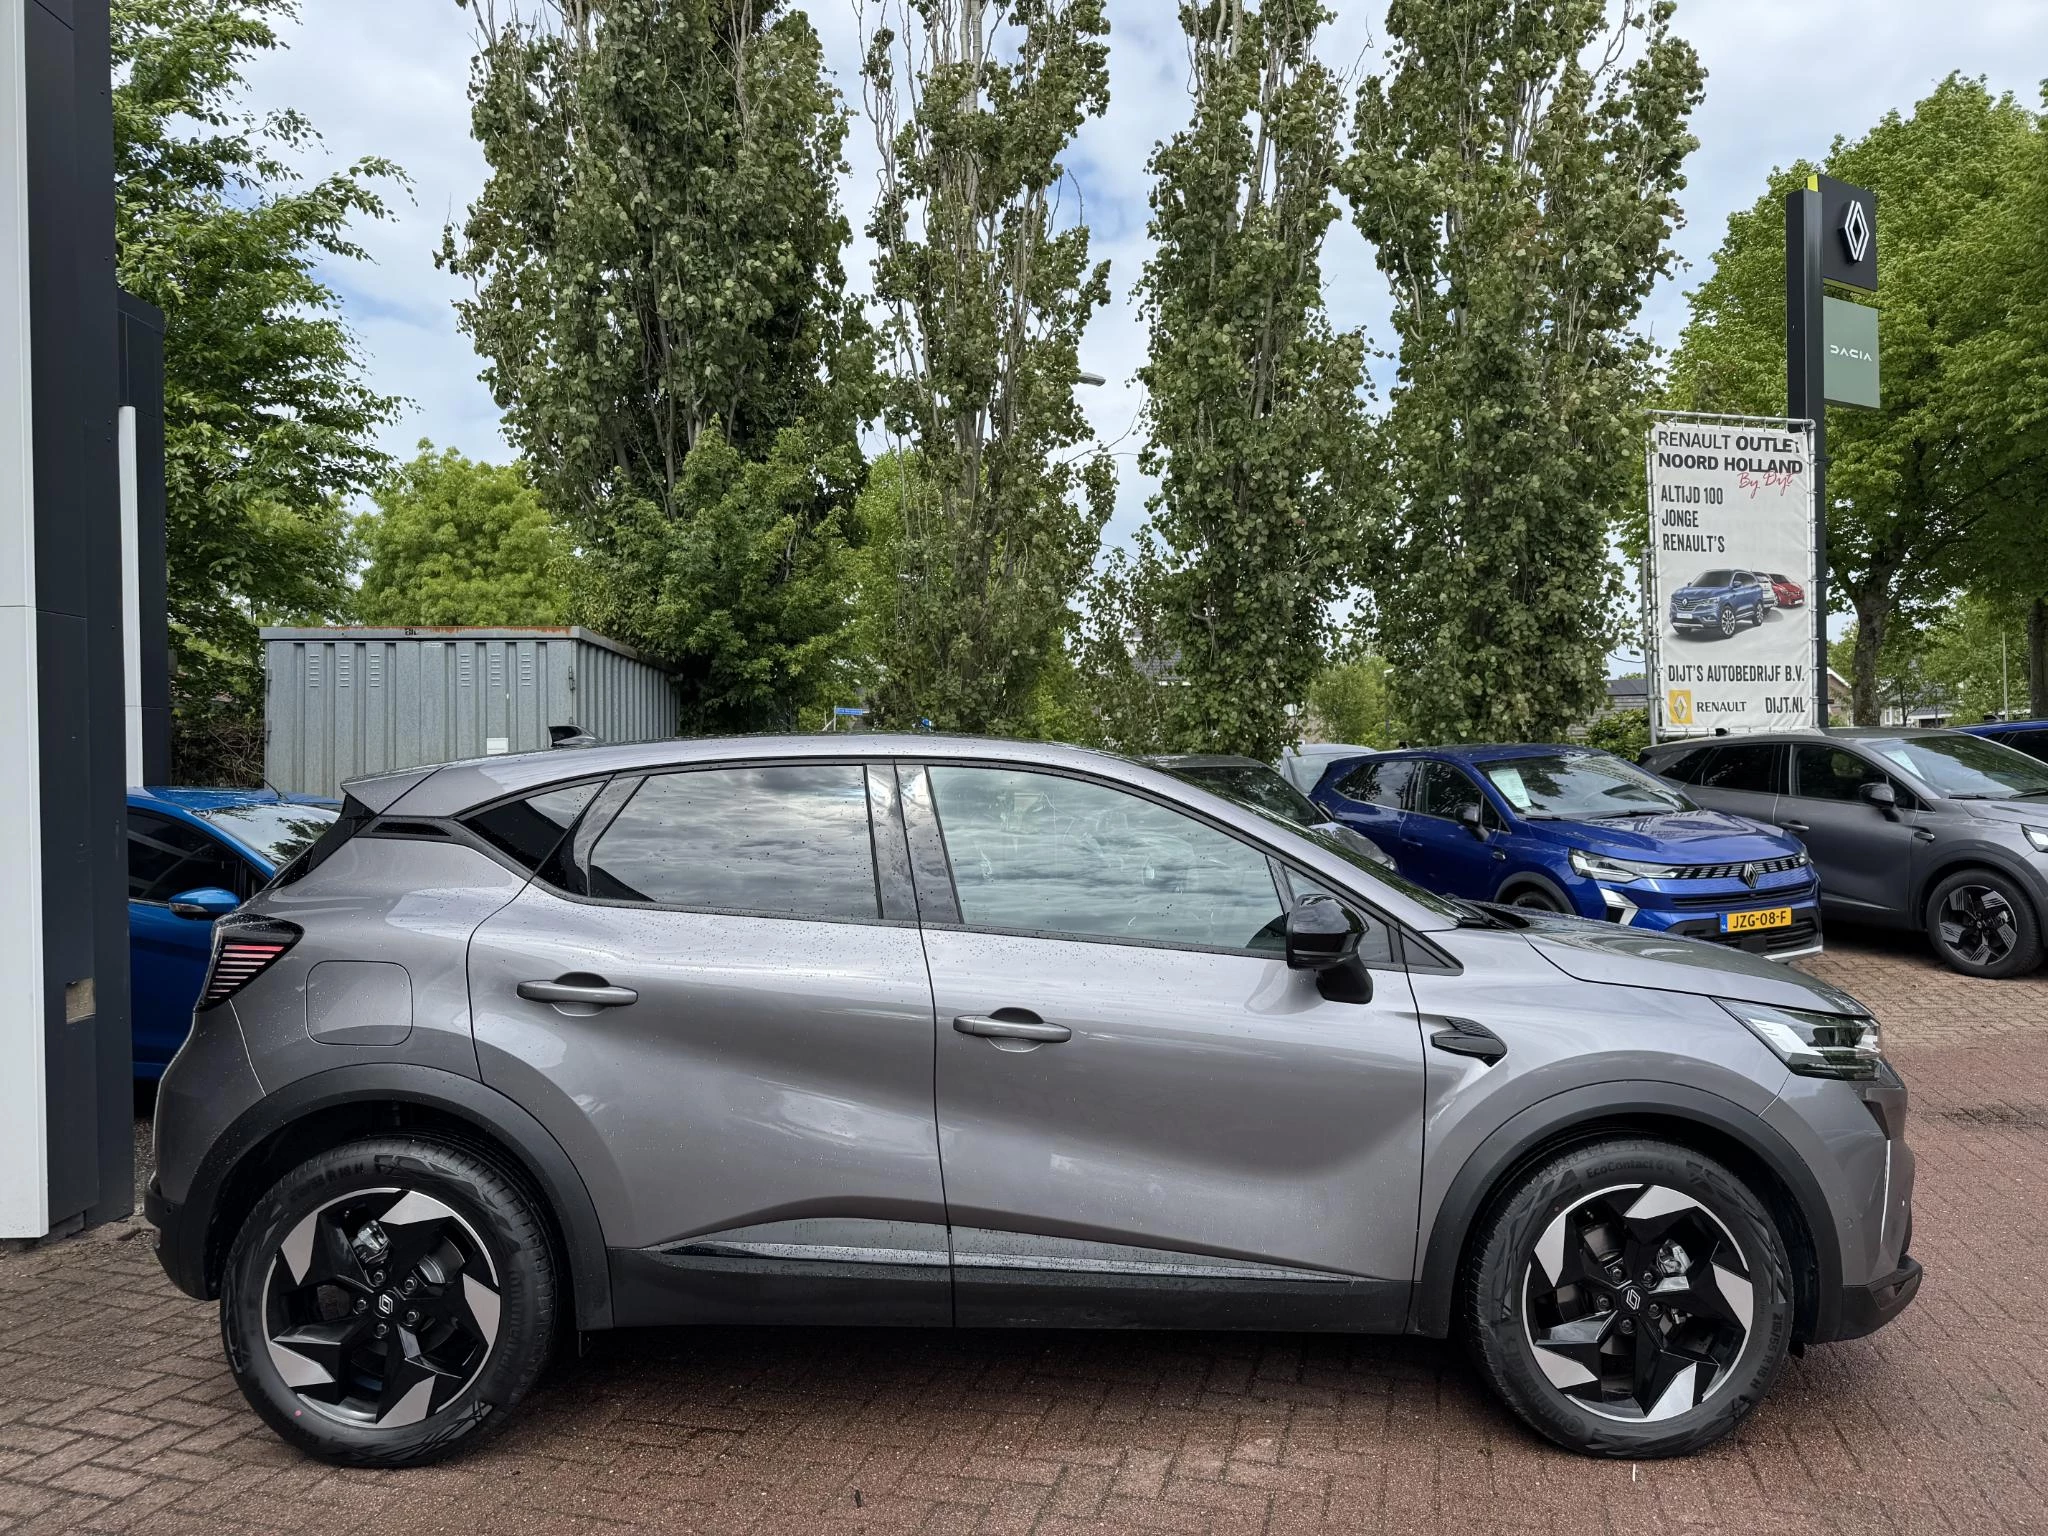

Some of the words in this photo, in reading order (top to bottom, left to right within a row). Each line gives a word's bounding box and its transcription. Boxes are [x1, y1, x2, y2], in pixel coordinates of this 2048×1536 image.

[1830, 344, 1872, 361] DACIA
[1658, 431, 1731, 450] RENAULT
[1658, 453, 1719, 470] NOORD
[1724, 457, 1803, 474] HOLLAND
[1661, 485, 1700, 503] ALTIJD
[1704, 487, 1723, 505] 100
[1737, 472, 1760, 499] By
[1662, 509, 1699, 527] JONGE
[1663, 533, 1725, 552] RENAULT'S
[1668, 665, 1703, 682] DIJT'S
[1707, 665, 1781, 682] AUTOBEDRIJF
[1785, 665, 1805, 682] B.V.
[1696, 701, 1747, 712] RENAULT
[1765, 697, 1805, 714] DIJT.NL
[1733, 910, 1787, 929] JZG-08-F
